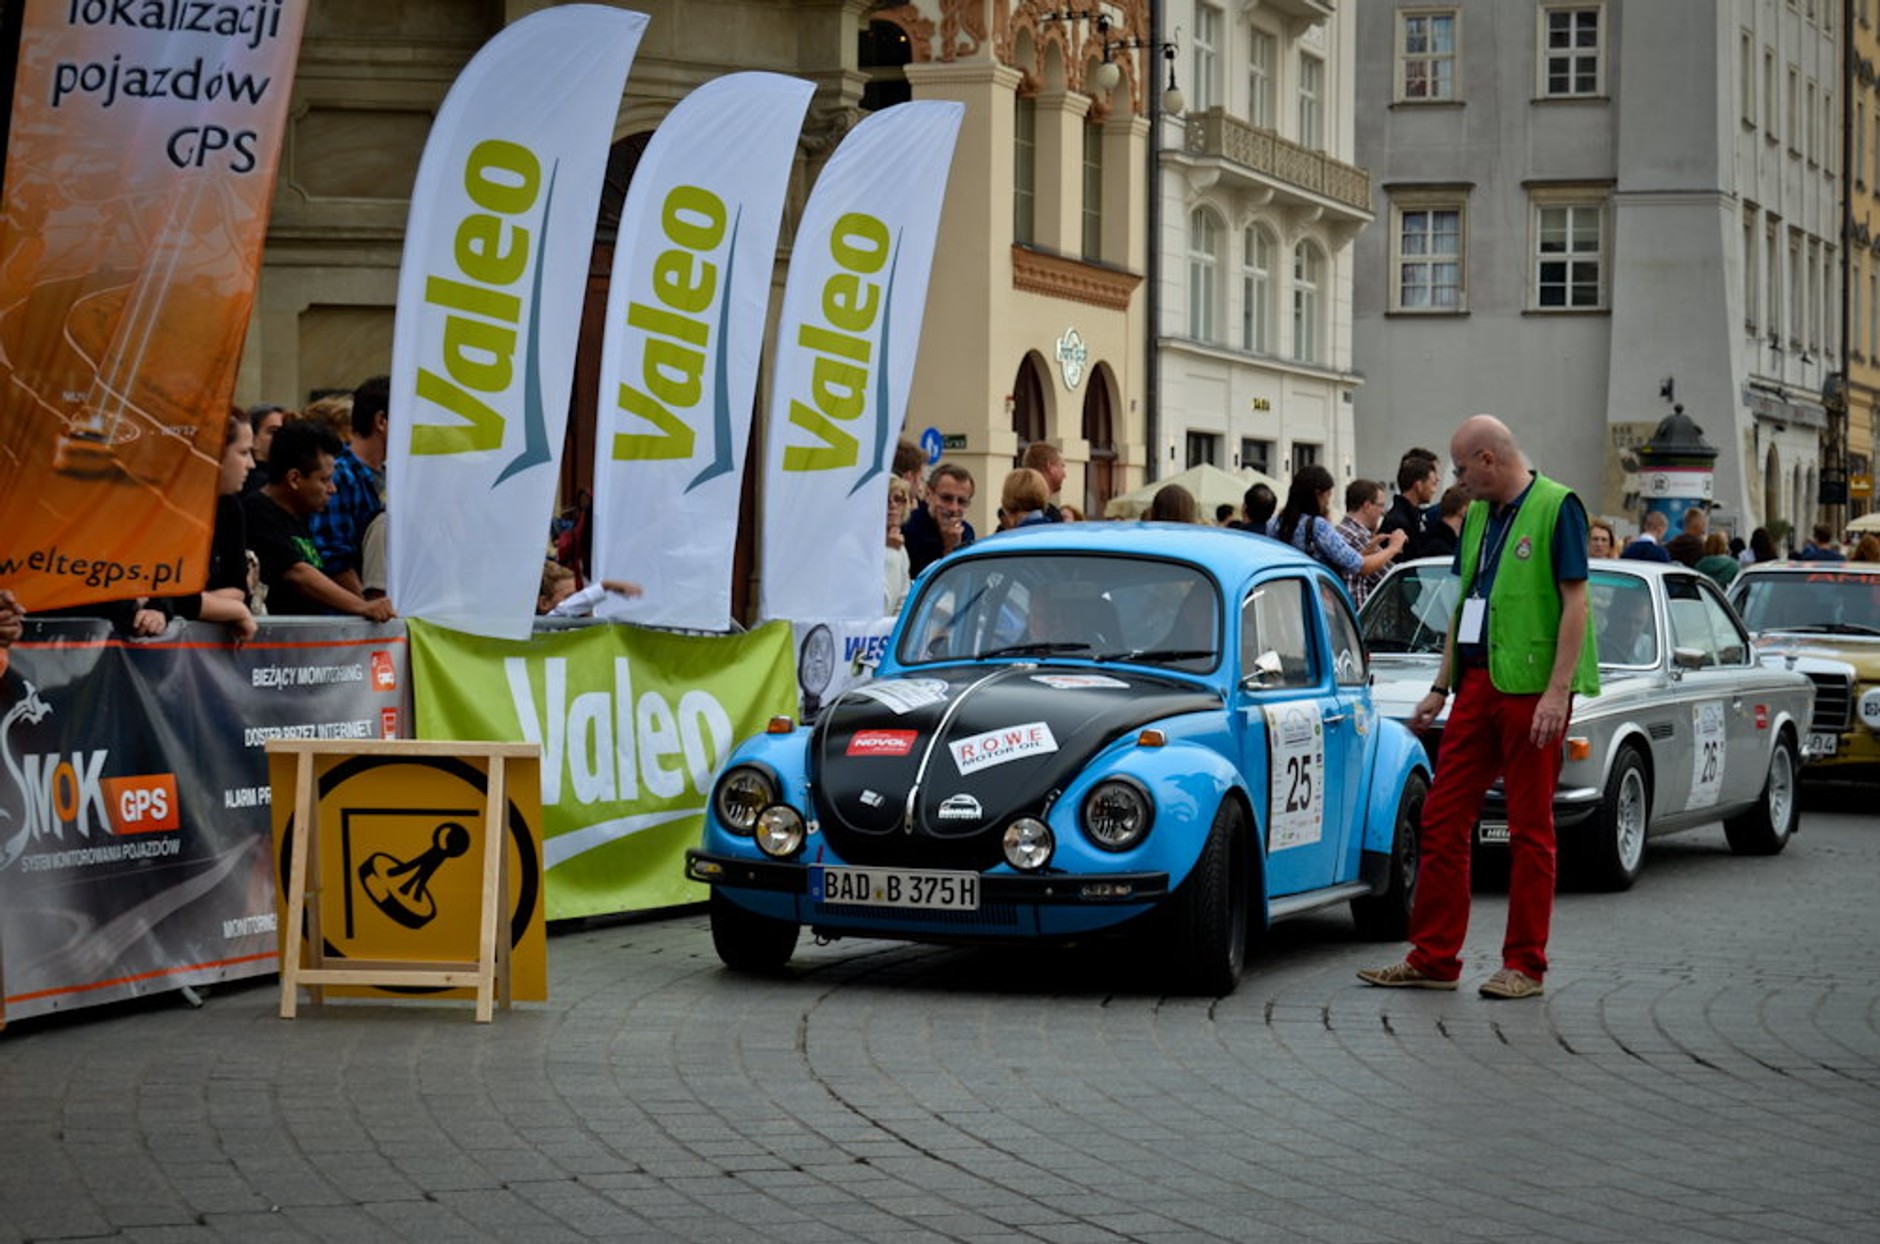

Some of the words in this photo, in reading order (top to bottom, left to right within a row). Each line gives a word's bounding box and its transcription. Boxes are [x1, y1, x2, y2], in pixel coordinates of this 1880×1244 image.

[68, 0, 282, 49] lokalizacji
[52, 55, 271, 107] pojazdów
[166, 124, 257, 173] GPS
[409, 139, 541, 456] Valeo
[612, 184, 727, 461] Valeo
[782, 212, 890, 472] Valeo
[297, 663, 362, 685] MONITORING
[504, 657, 733, 805] Valeo
[854, 739, 907, 747] NOVOL
[961, 727, 1041, 759] ROWE
[962, 746, 1014, 766] MOTOR
[1701, 741, 1717, 783] 26
[225, 788, 257, 808] ALARM
[1286, 755, 1311, 812] 25
[120, 788, 168, 822] GPS
[122, 836, 181, 860] POJAZDÓW
[825, 872, 869, 900] BAD
[887, 876, 901, 902] B
